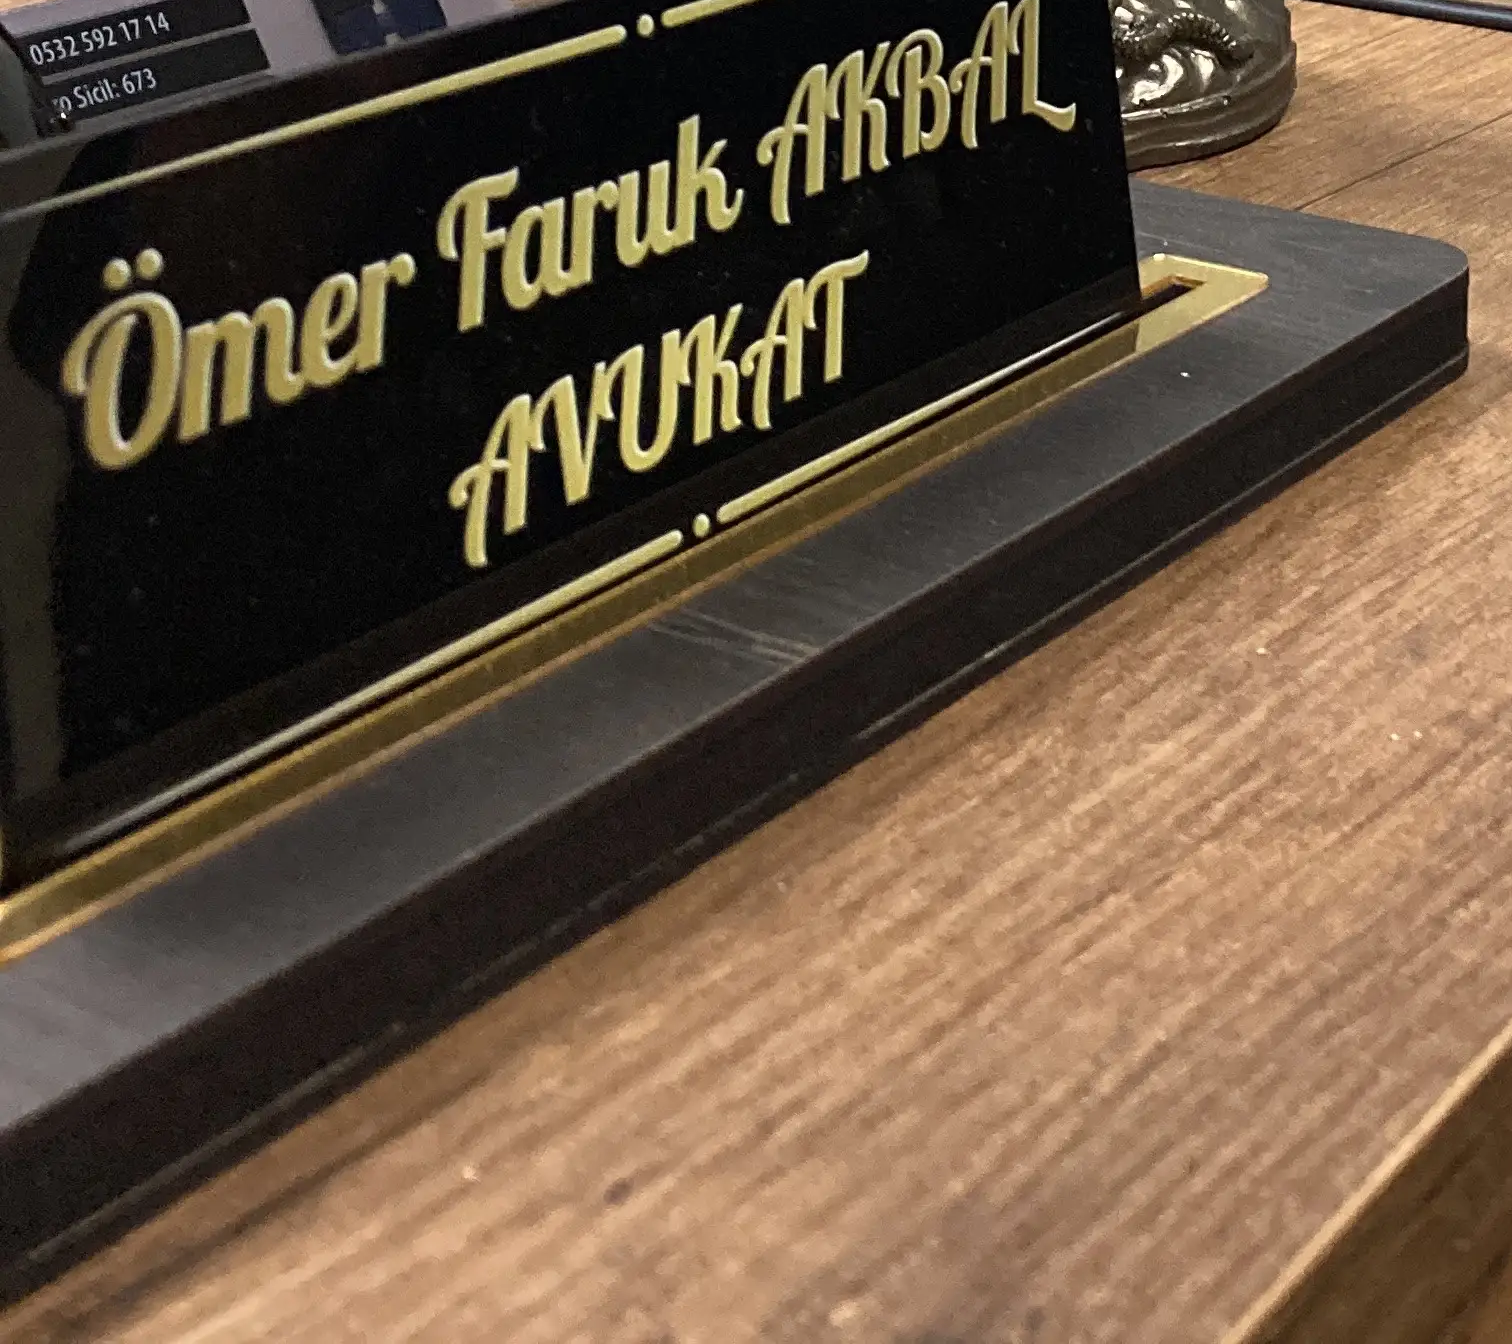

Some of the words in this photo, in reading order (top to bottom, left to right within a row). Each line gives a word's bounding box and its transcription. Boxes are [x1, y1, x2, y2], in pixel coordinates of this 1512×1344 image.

[29, 35, 80, 66] 0532
[80, 26, 118, 53] 592
[118, 17, 141, 42] 17
[144, 12, 170, 35] 14
[73, 78, 121, 109] Sicil:
[121, 68, 157, 94] 673
[63, 248, 416, 468] Ömer
[437, 114, 743, 332] Faruk
[448, 251, 869, 567] AVUKAT
